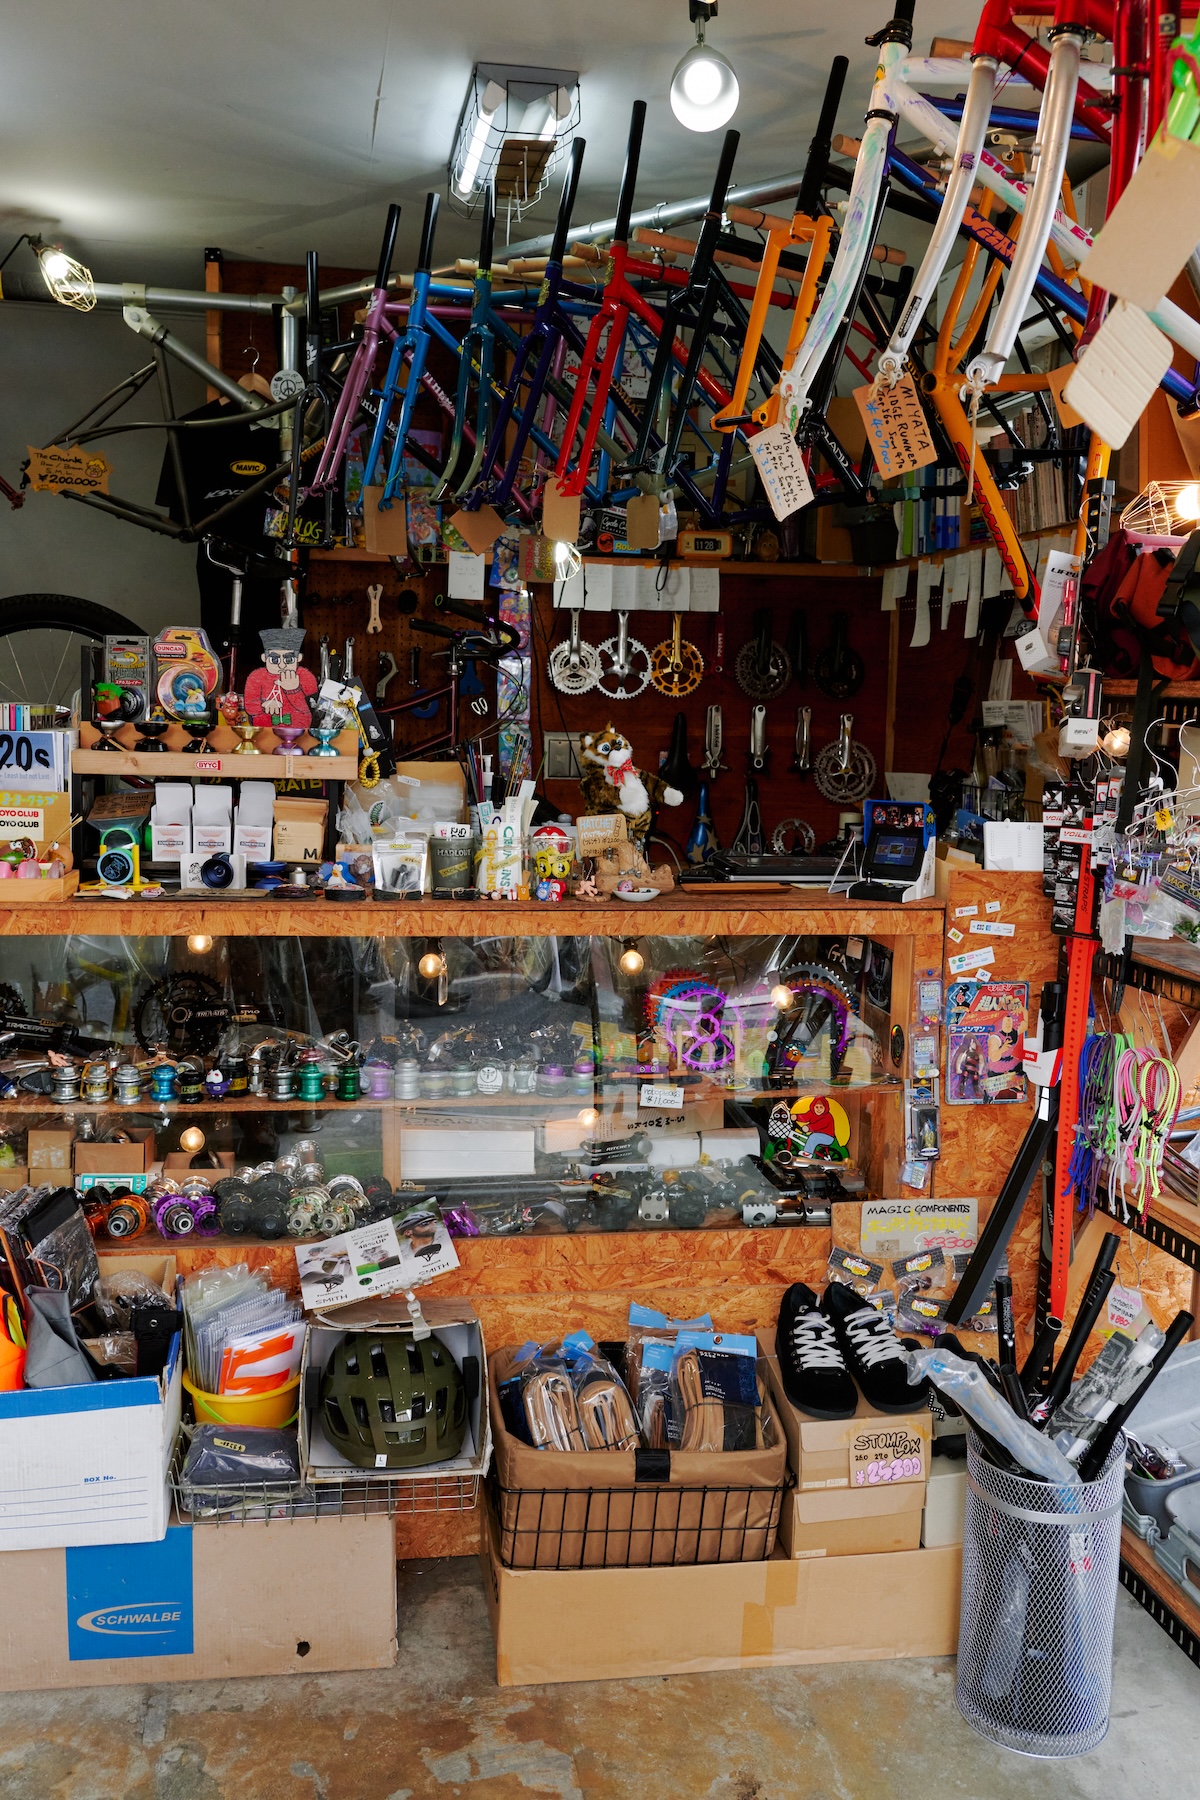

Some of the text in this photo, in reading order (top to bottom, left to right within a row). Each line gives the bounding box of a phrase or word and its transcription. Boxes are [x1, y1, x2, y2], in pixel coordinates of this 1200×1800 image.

[900, 386, 930, 450] MIYATA
[898, 422, 918, 467] RUNNER
[49, 454, 82, 464] Chunk
[773, 444, 789, 471] Black
[236, 464, 260, 472] MAVIC
[17, 810, 39, 818] CLUB
[1045, 815, 1063, 823] VOIL
[580, 817, 615, 830] HATCHET
[303, 848, 318, 859] M
[1166, 875, 1189, 892] MAGIC
[1081, 877, 1091, 915] STRAPS
[957, 993, 965, 1003] 6
[867, 1204, 970, 1215] MAGIC COMPONENTS
[418, 1262, 450, 1276] SMITH
[315, 1294, 348, 1305] SMITH
[854, 1432, 908, 1451] STOMP
[893, 1438, 921, 1459] LOX
[96, 1611, 182, 1625] SCHWALBE
